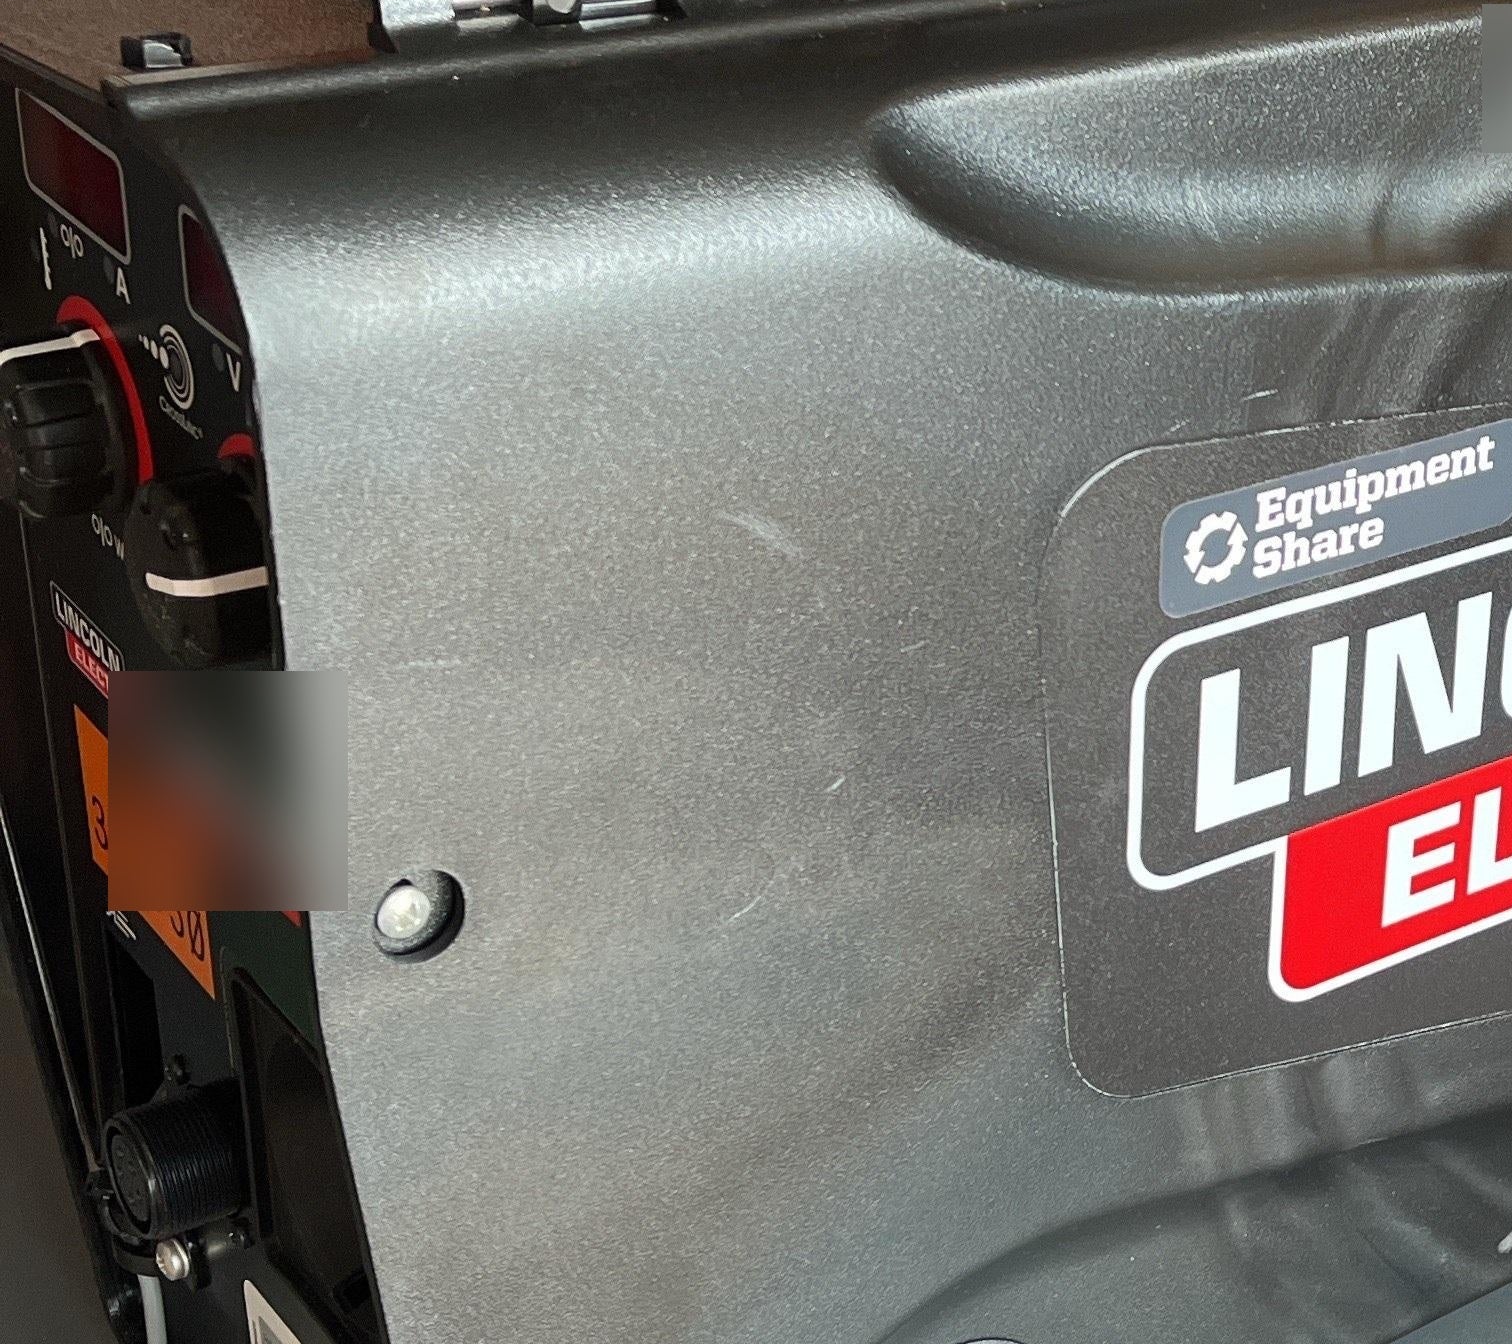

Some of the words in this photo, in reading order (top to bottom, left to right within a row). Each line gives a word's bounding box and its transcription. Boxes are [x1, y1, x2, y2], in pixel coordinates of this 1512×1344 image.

[1255, 435, 1496, 531] Equipment
[1253, 517, 1385, 579] Share
[54, 592, 120, 672] LINCOLN
